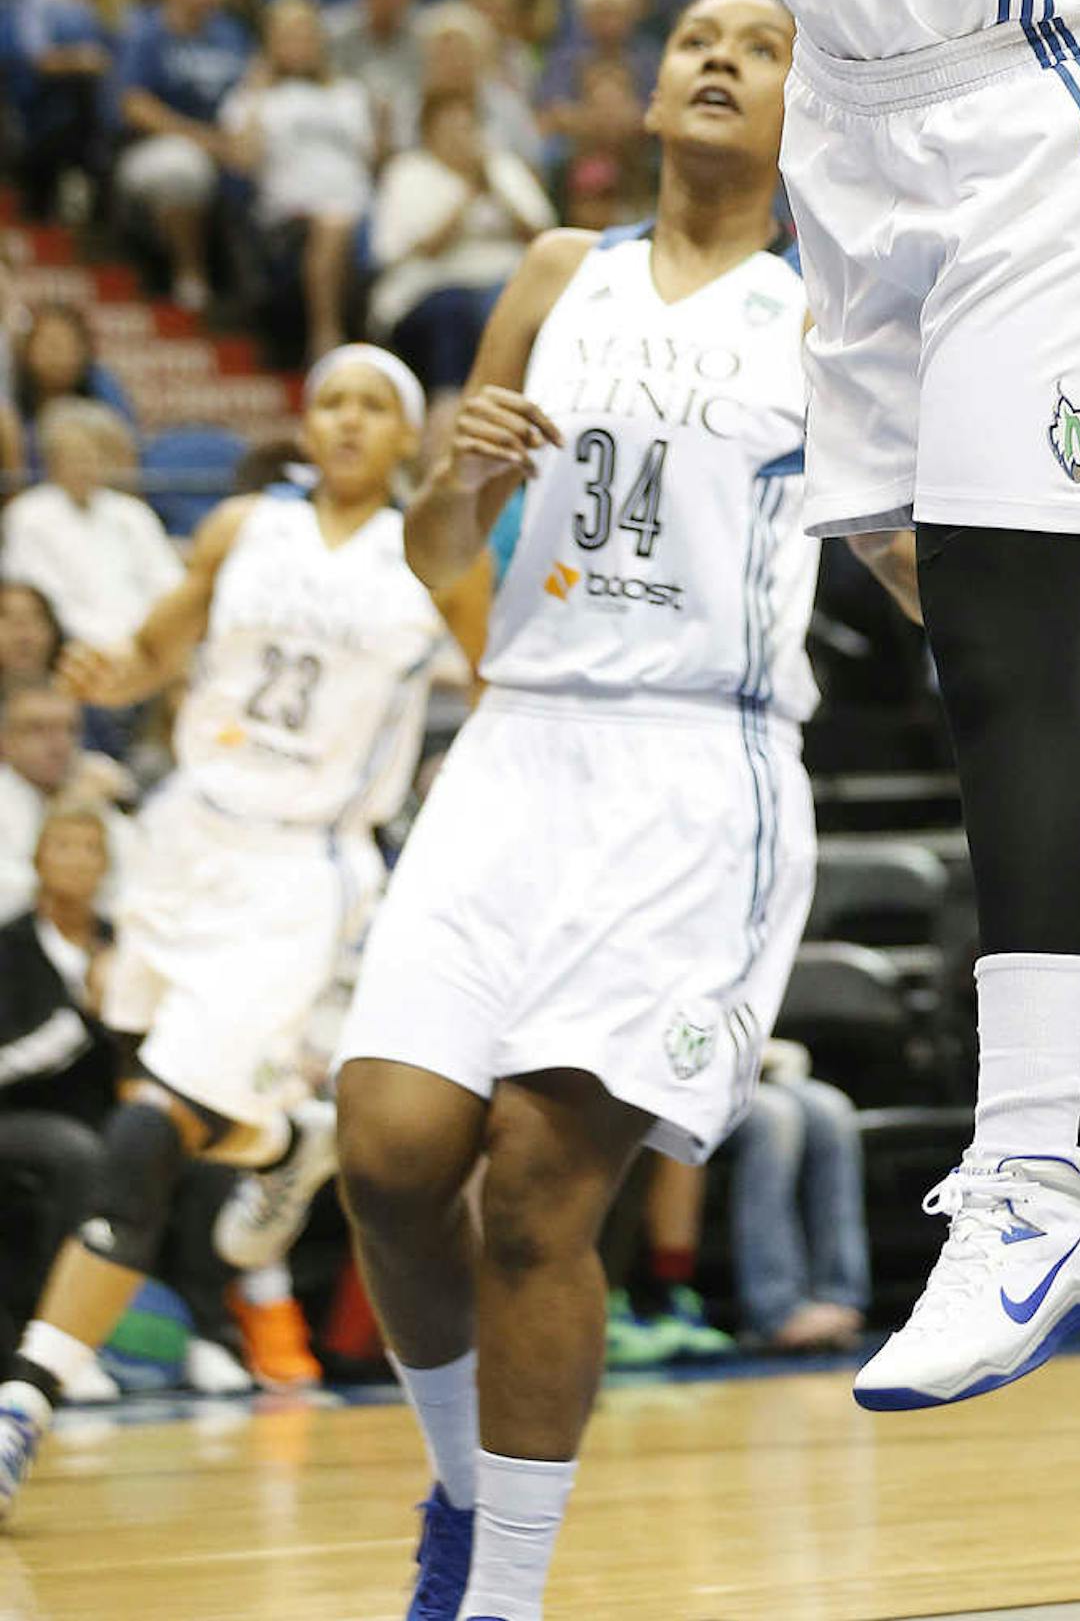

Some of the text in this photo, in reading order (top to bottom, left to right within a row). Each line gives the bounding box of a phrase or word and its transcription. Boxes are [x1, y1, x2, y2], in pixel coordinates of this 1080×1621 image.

[570, 378, 748, 441] LINIC
[572, 428, 668, 559] 34
[243, 642, 322, 737] 23
